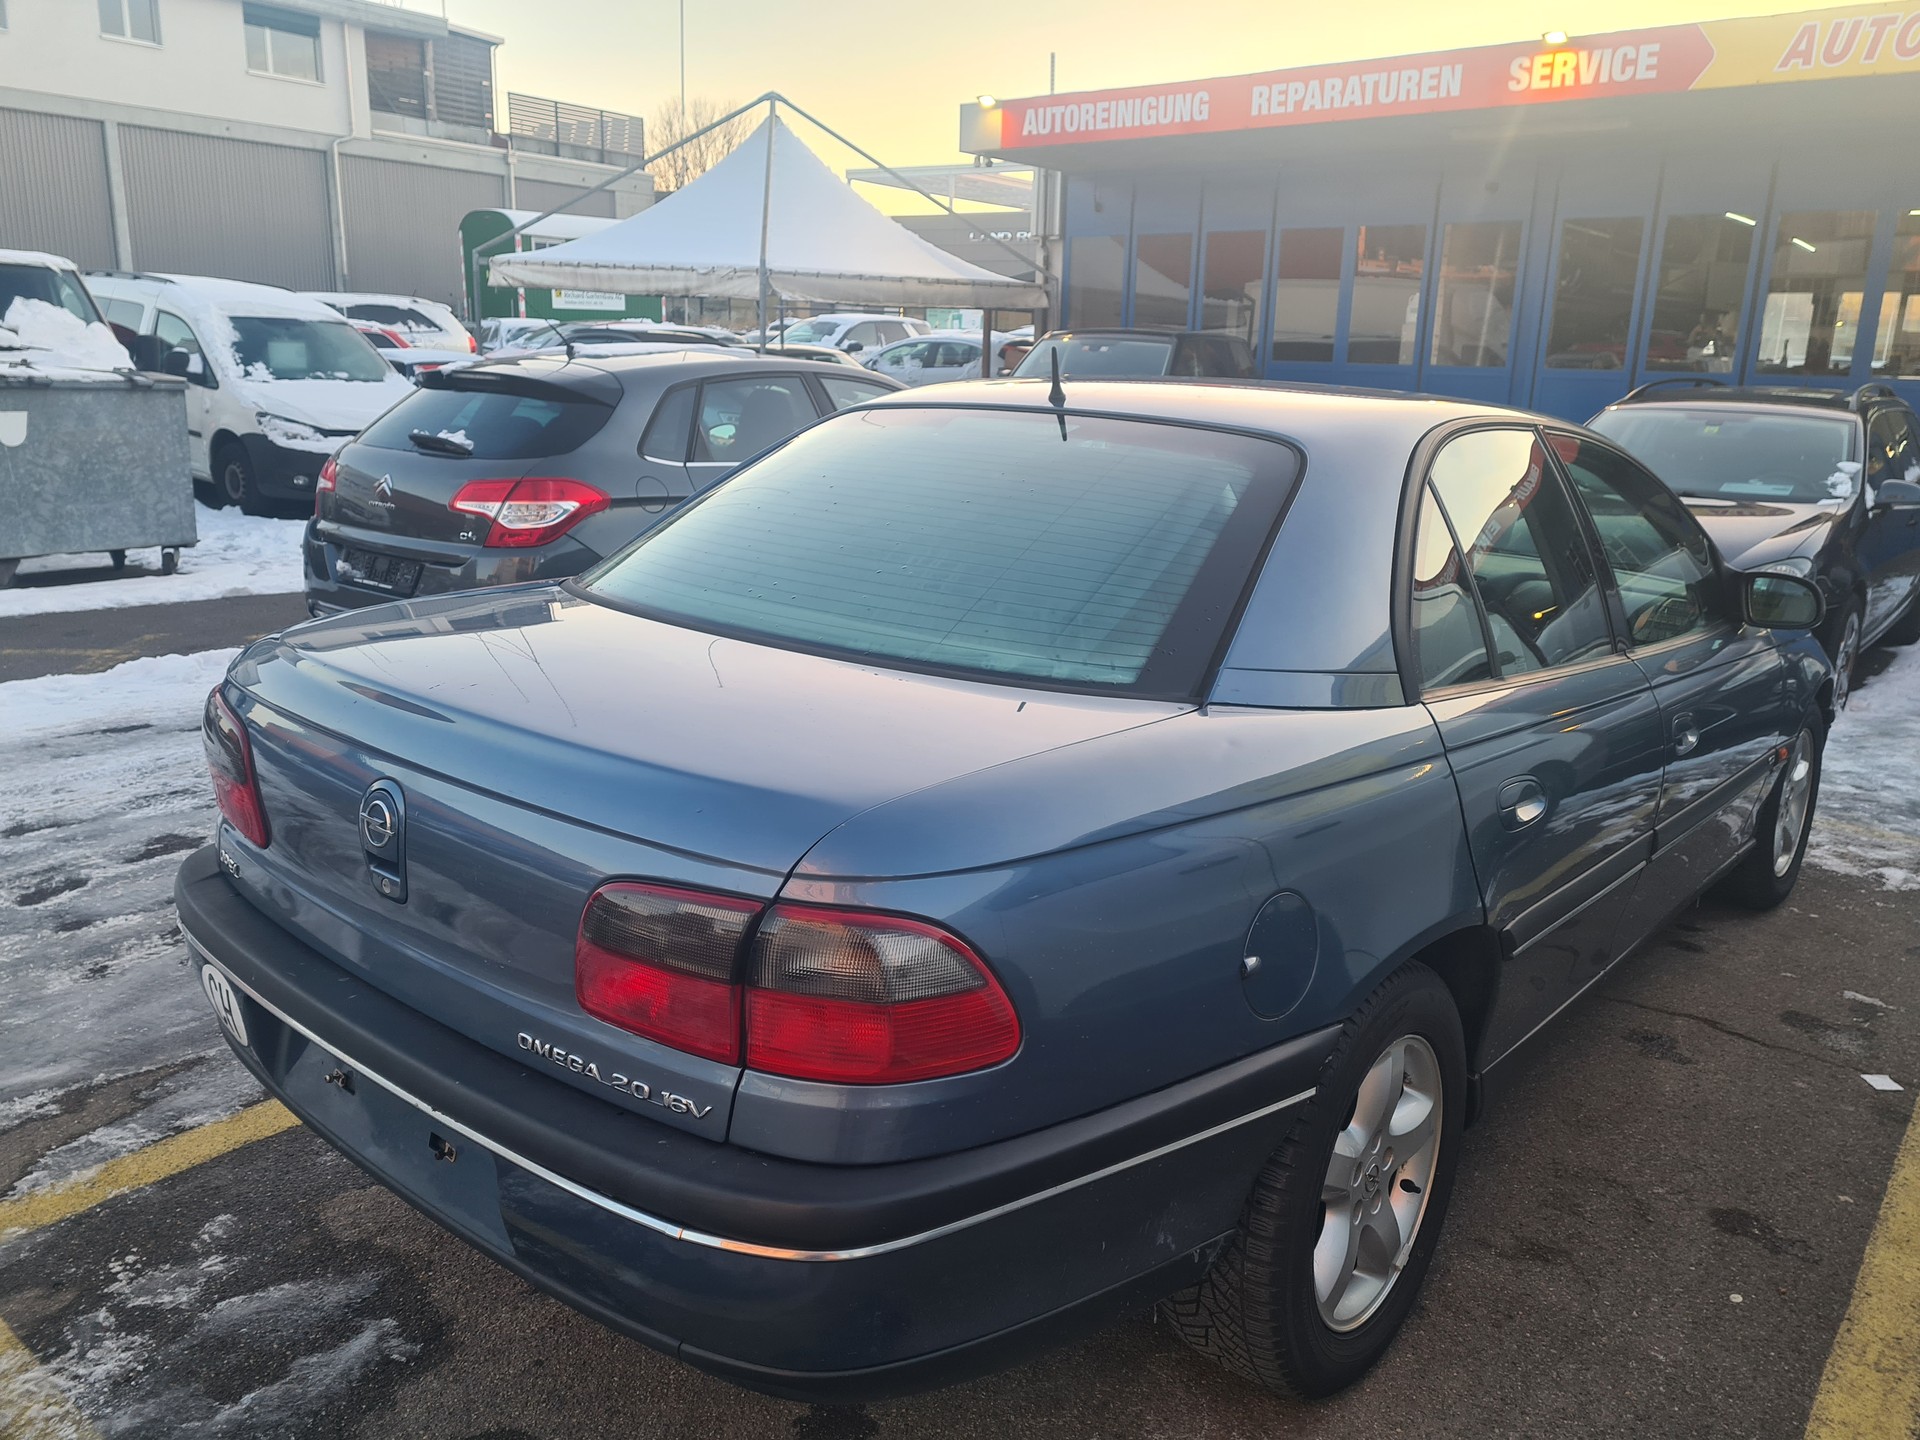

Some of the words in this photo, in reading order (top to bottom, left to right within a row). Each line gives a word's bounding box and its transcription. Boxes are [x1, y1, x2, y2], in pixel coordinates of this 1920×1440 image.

[1022, 91, 1210, 136] AUTOREINIGUNG
[1251, 64, 1463, 116] REPARATUREN
[1507, 43, 1660, 92] SERVICE
[208, 973, 242, 1040] CH
[517, 1032, 602, 1082] OMEGA
[660, 1090, 713, 1119] 16V
